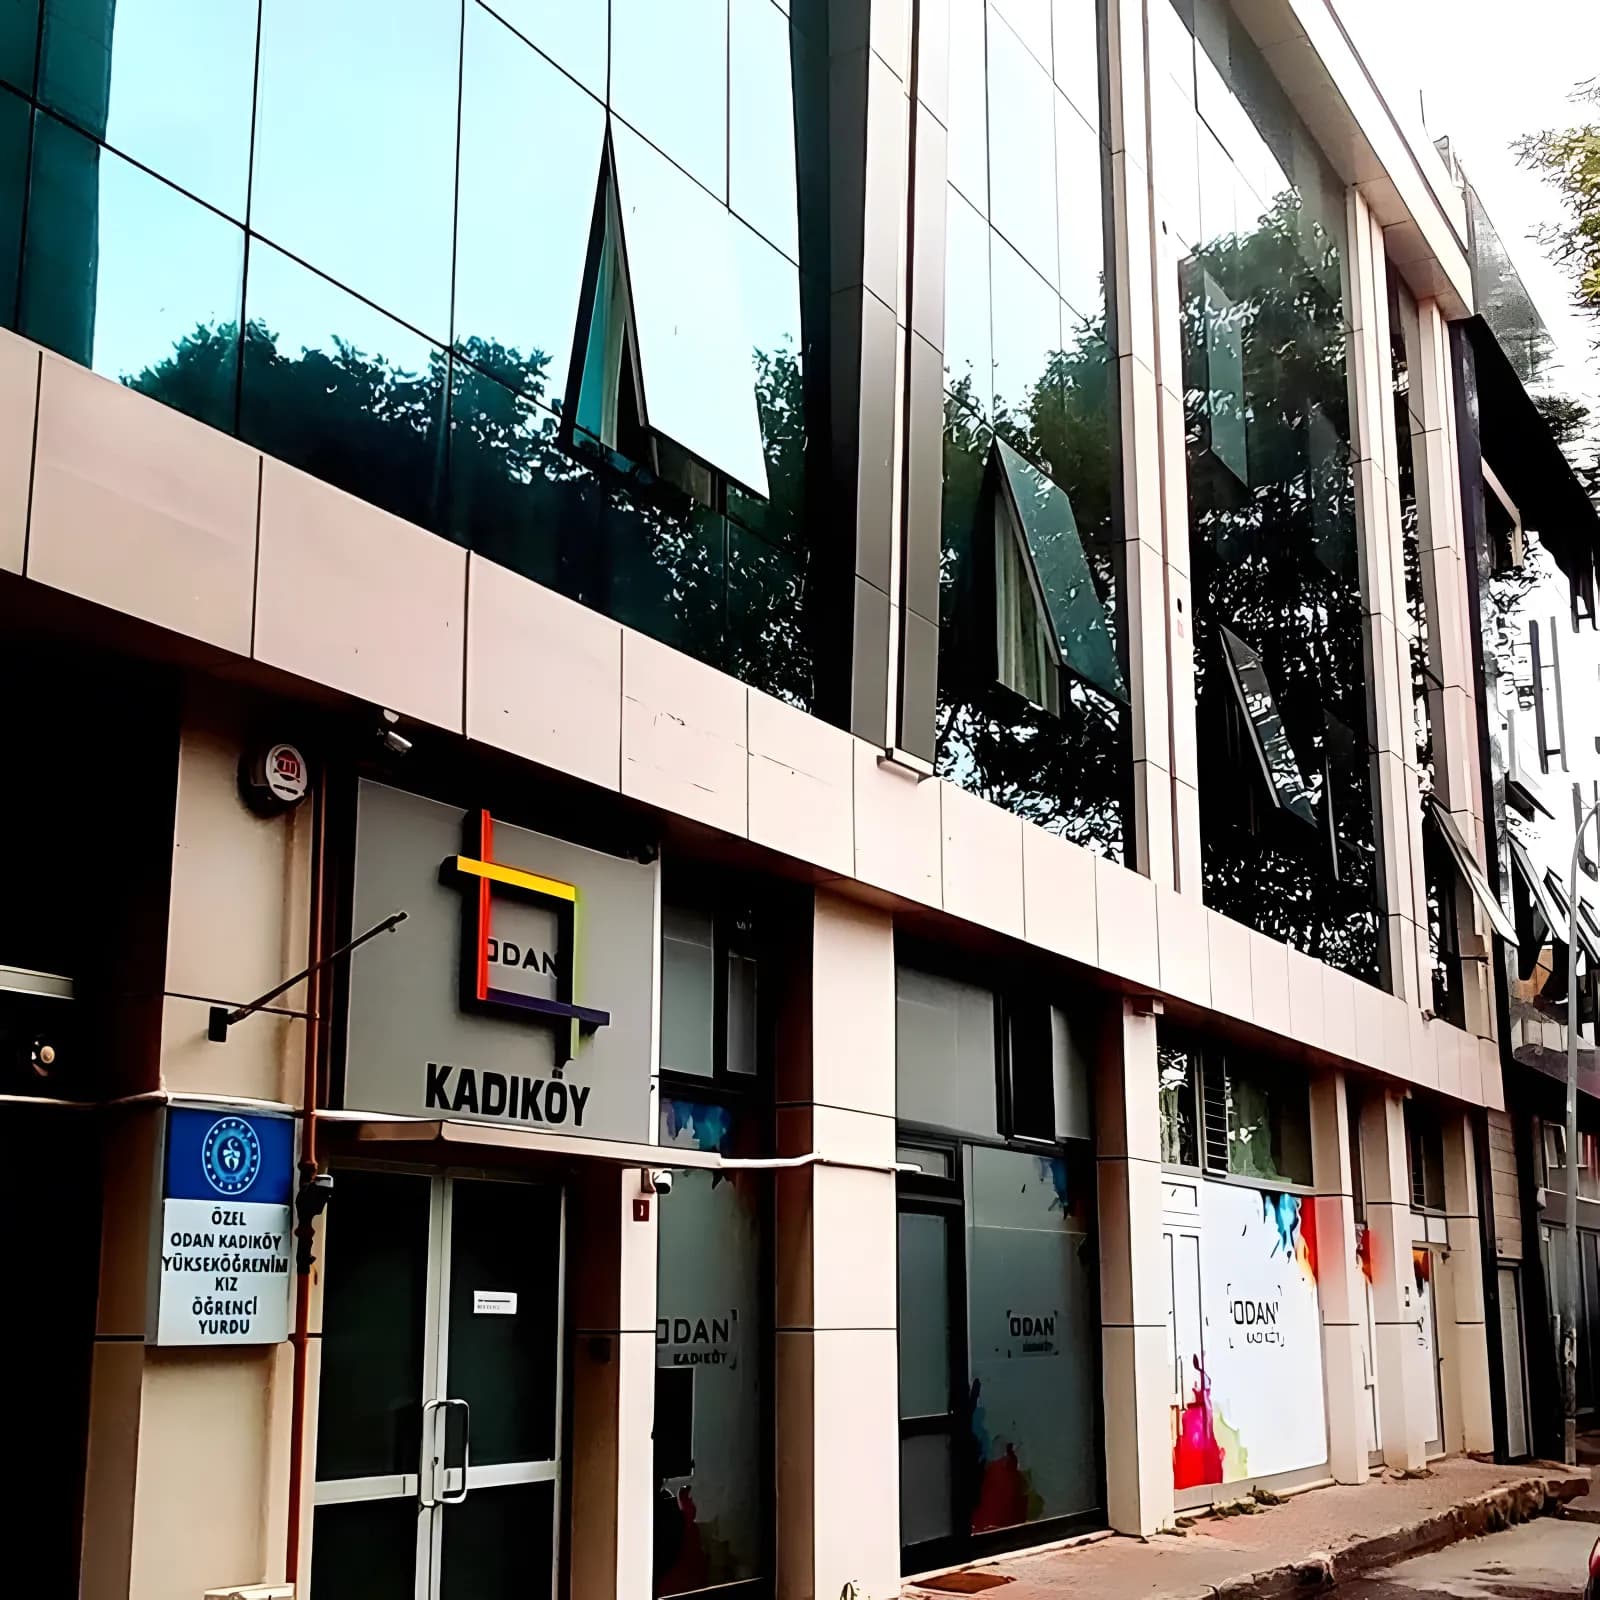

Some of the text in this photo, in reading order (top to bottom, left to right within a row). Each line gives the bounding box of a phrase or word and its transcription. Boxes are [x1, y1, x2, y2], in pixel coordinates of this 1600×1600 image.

[487, 938, 558, 978] ODAN
[425, 1062, 591, 1127] KADIKÖY
[211, 1206, 247, 1226] ÖZEL
[170, 1232, 282, 1251] ODAN KADIKÖY
[162, 1252, 288, 1273] YÜKSEKÖĞRENİM
[215, 1276, 238, 1291] KIZ
[192, 1296, 258, 1316] ÖĞRENCİ
[1233, 1300, 1276, 1325] ODAN
[199, 1319, 250, 1335] YURDU
[656, 1318, 729, 1344] ODAN
[1009, 1317, 1054, 1336] ODAN
